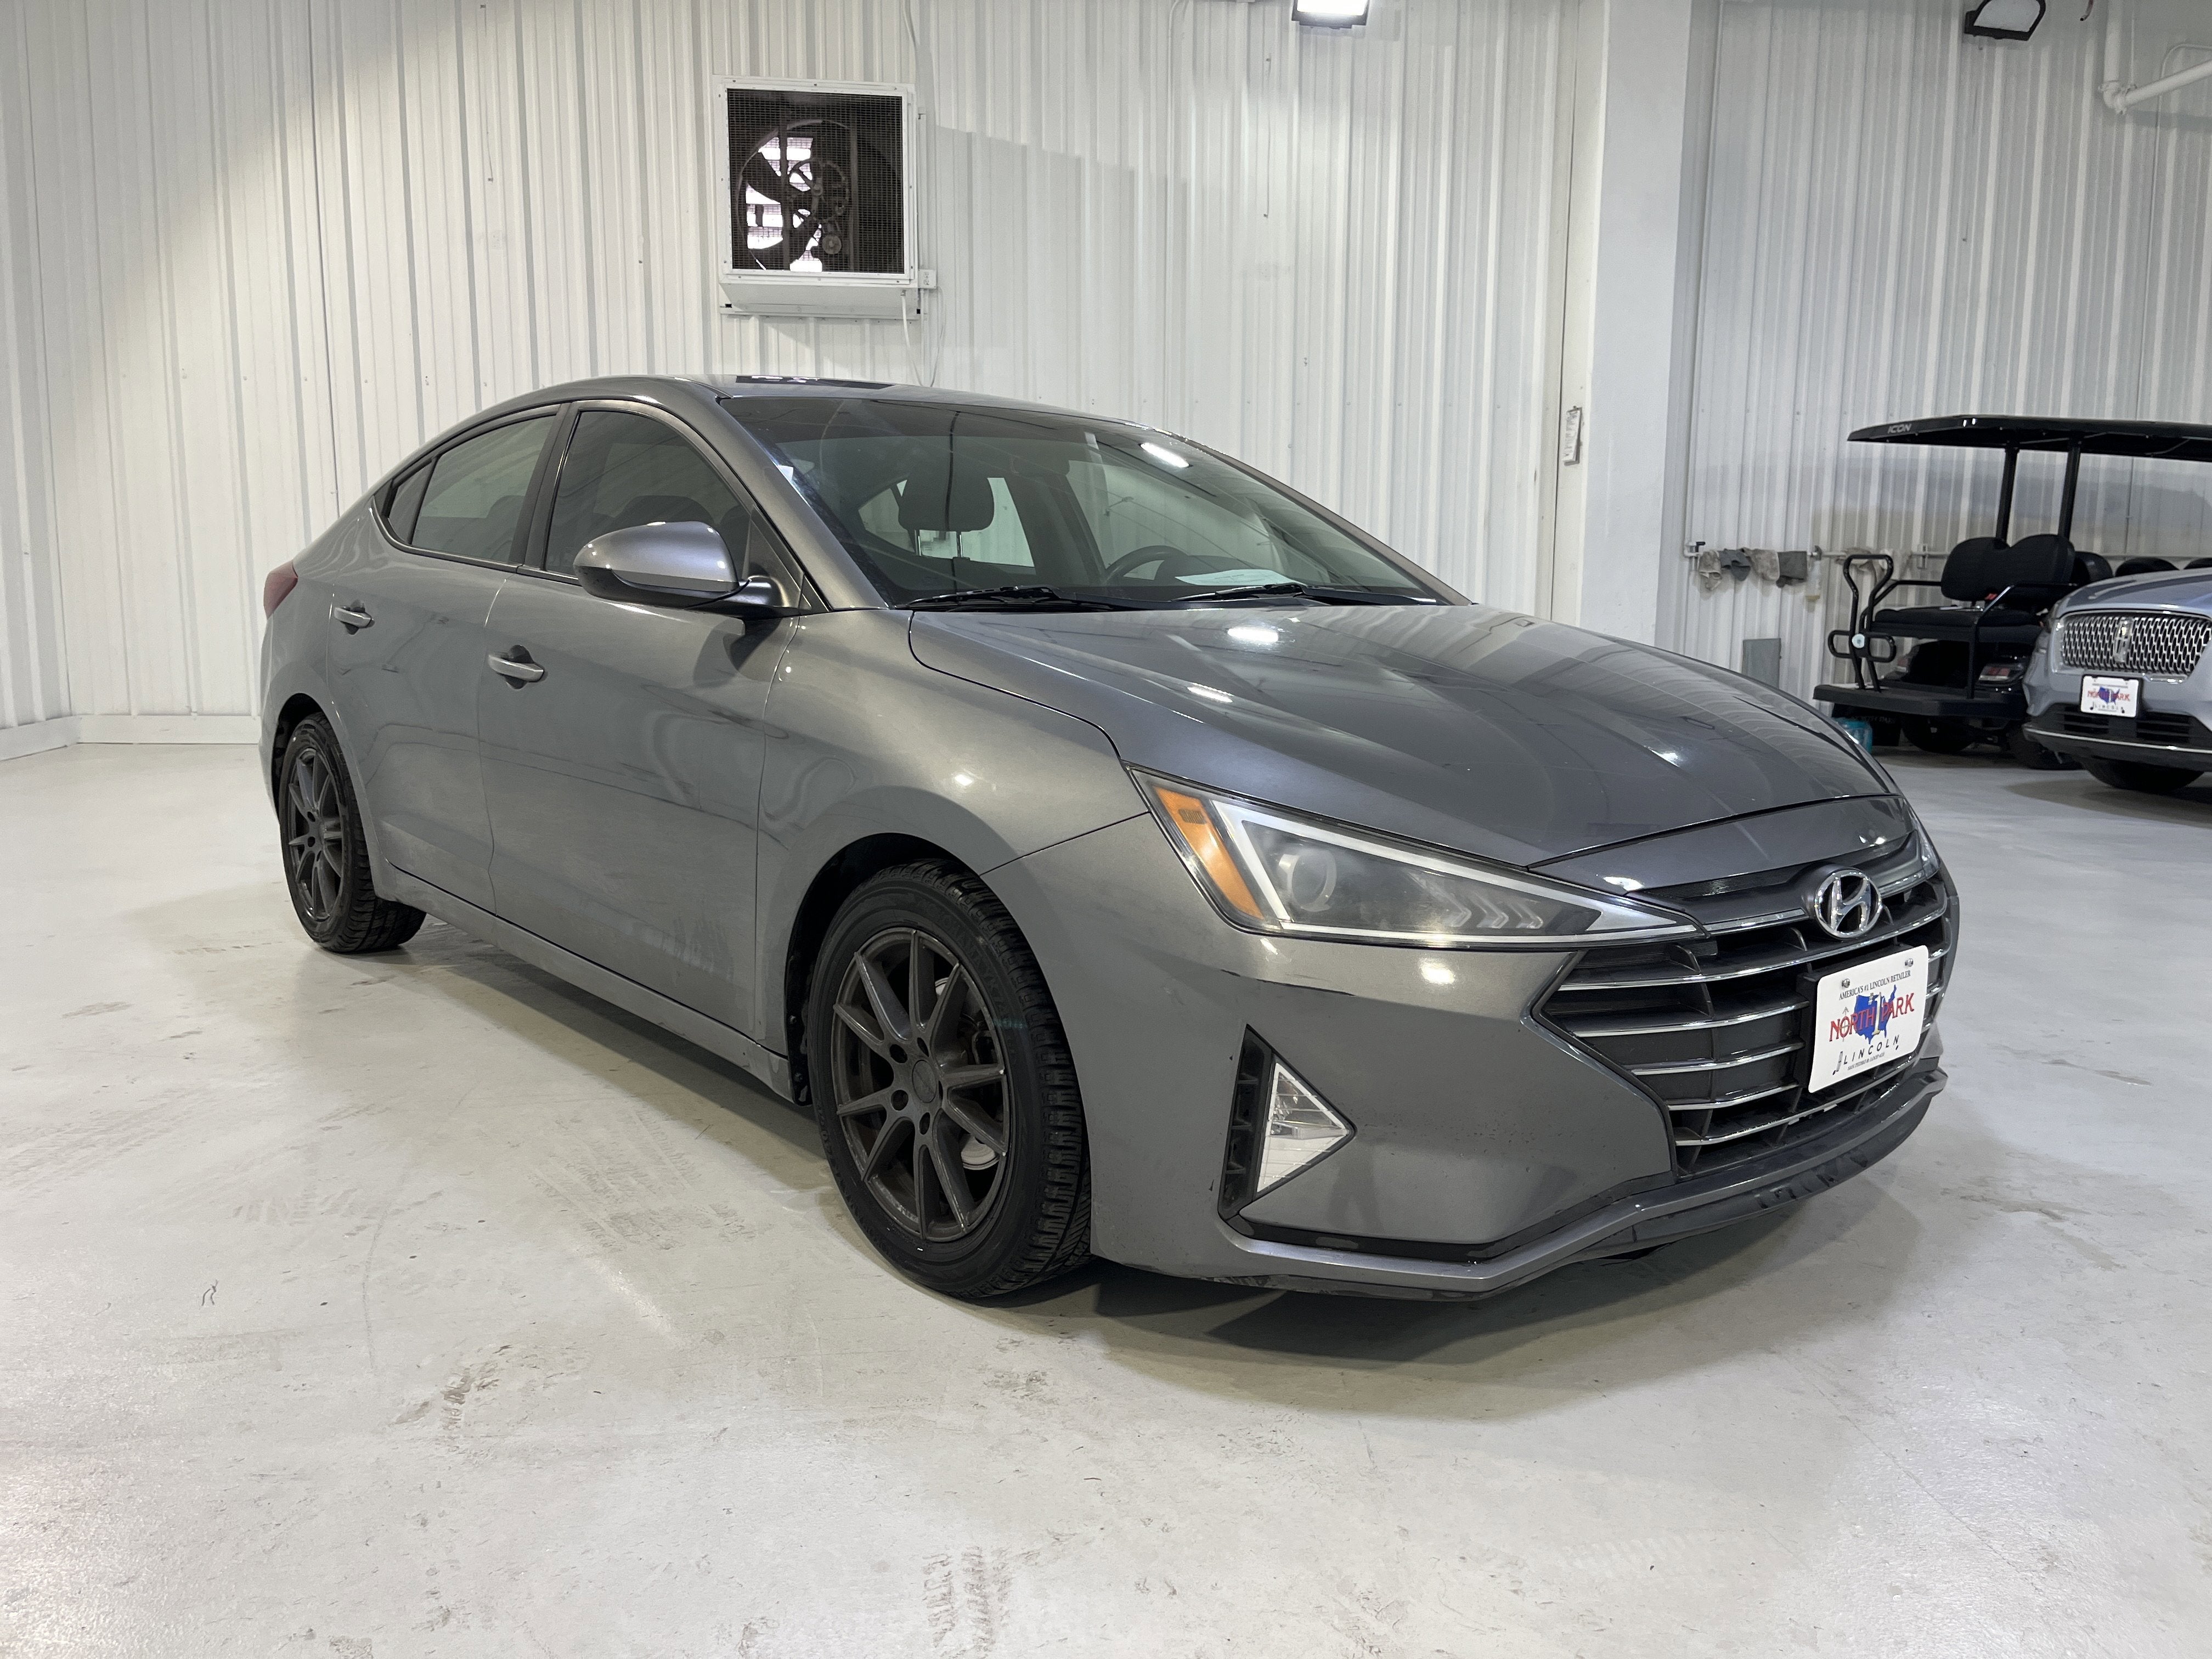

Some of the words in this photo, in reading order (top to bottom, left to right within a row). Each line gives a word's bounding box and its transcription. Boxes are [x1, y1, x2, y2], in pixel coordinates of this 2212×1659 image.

[1887, 424, 1912, 434] ICON
[1839, 985, 1864, 1001] AMERICA'S
[1869, 976, 1890, 990] LINCOLN
[1891, 970, 1911, 983] RETAILER
[1829, 1006, 1876, 1042] NORTH
[1881, 992, 1915, 1023] PARK
[1843, 1035, 1899, 1064] LINCOLN
